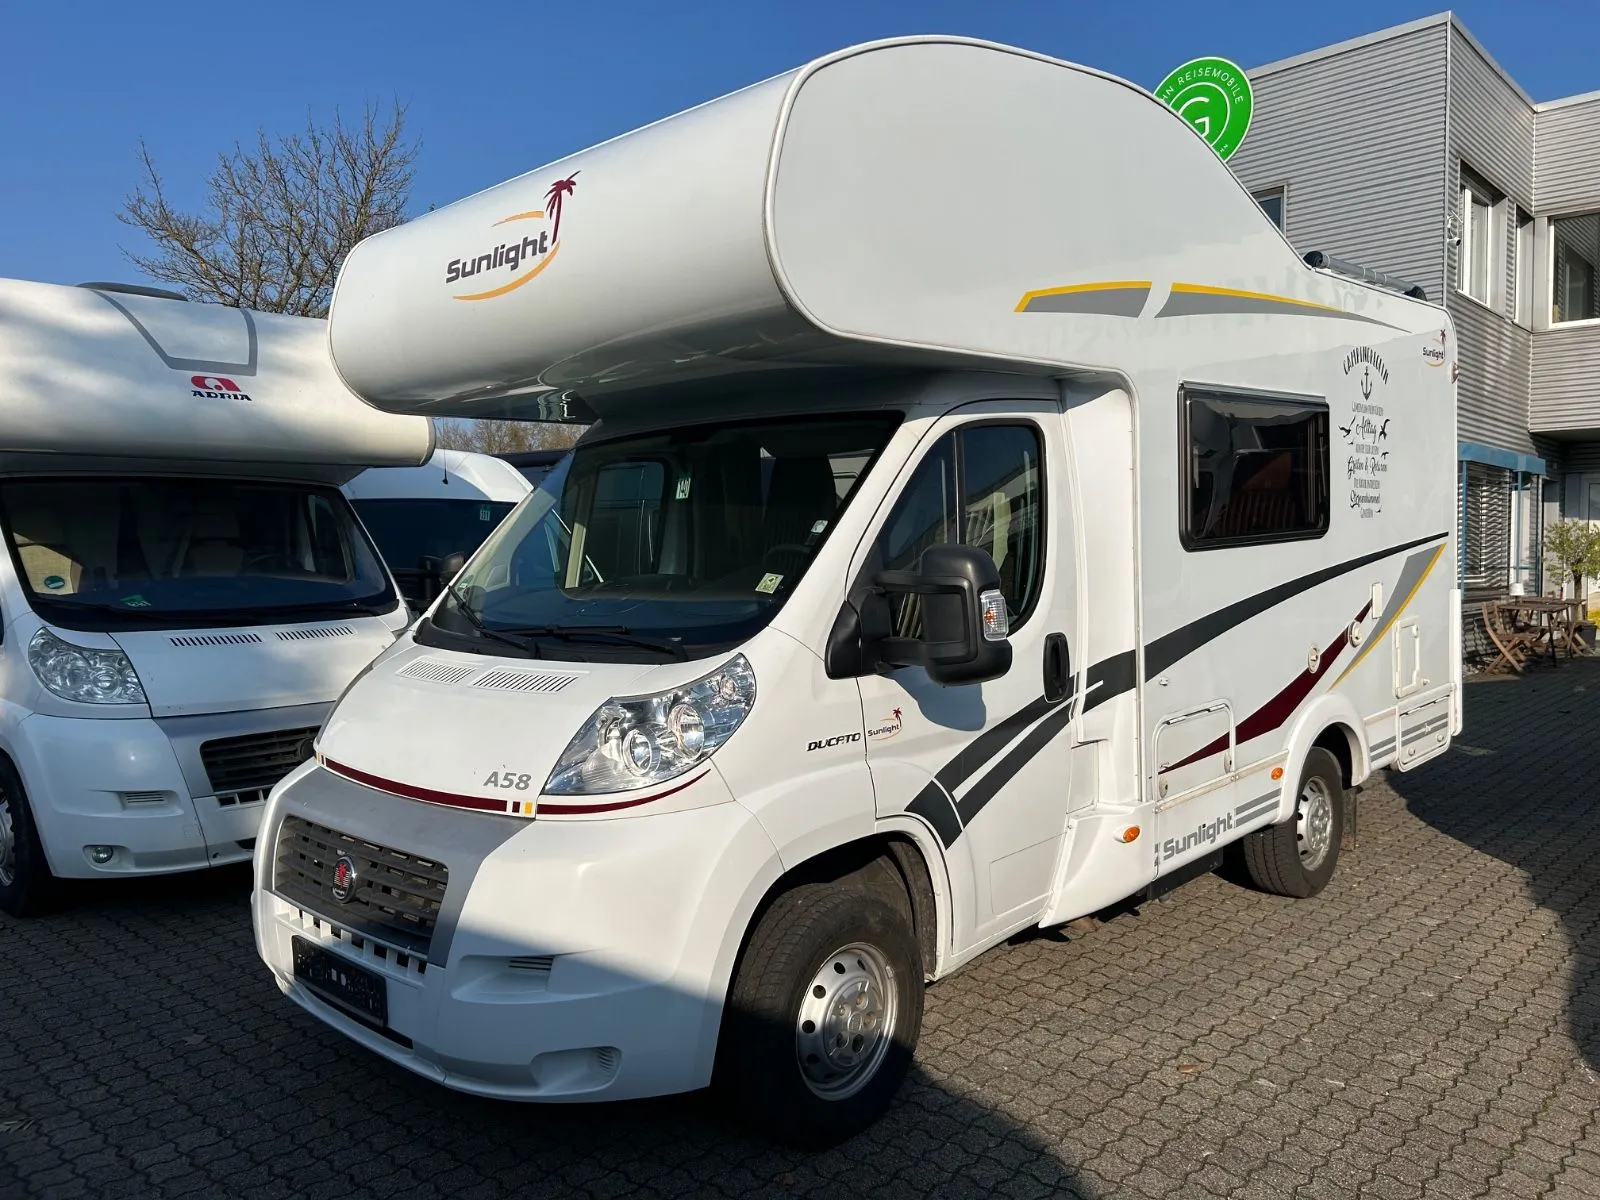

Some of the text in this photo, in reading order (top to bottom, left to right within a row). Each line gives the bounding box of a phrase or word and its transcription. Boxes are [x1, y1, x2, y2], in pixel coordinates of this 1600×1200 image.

[1177, 67, 1244, 104] REISEMOBILE
[446, 231, 548, 284] Sunlight
[1422, 346, 1444, 361] Sunlight
[191, 390, 252, 401] ADRIA
[867, 723, 900, 737] Sunlight
[806, 732, 861, 752] DUCATO
[483, 771, 532, 790] A58
[1163, 812, 1233, 861] Sunlight
